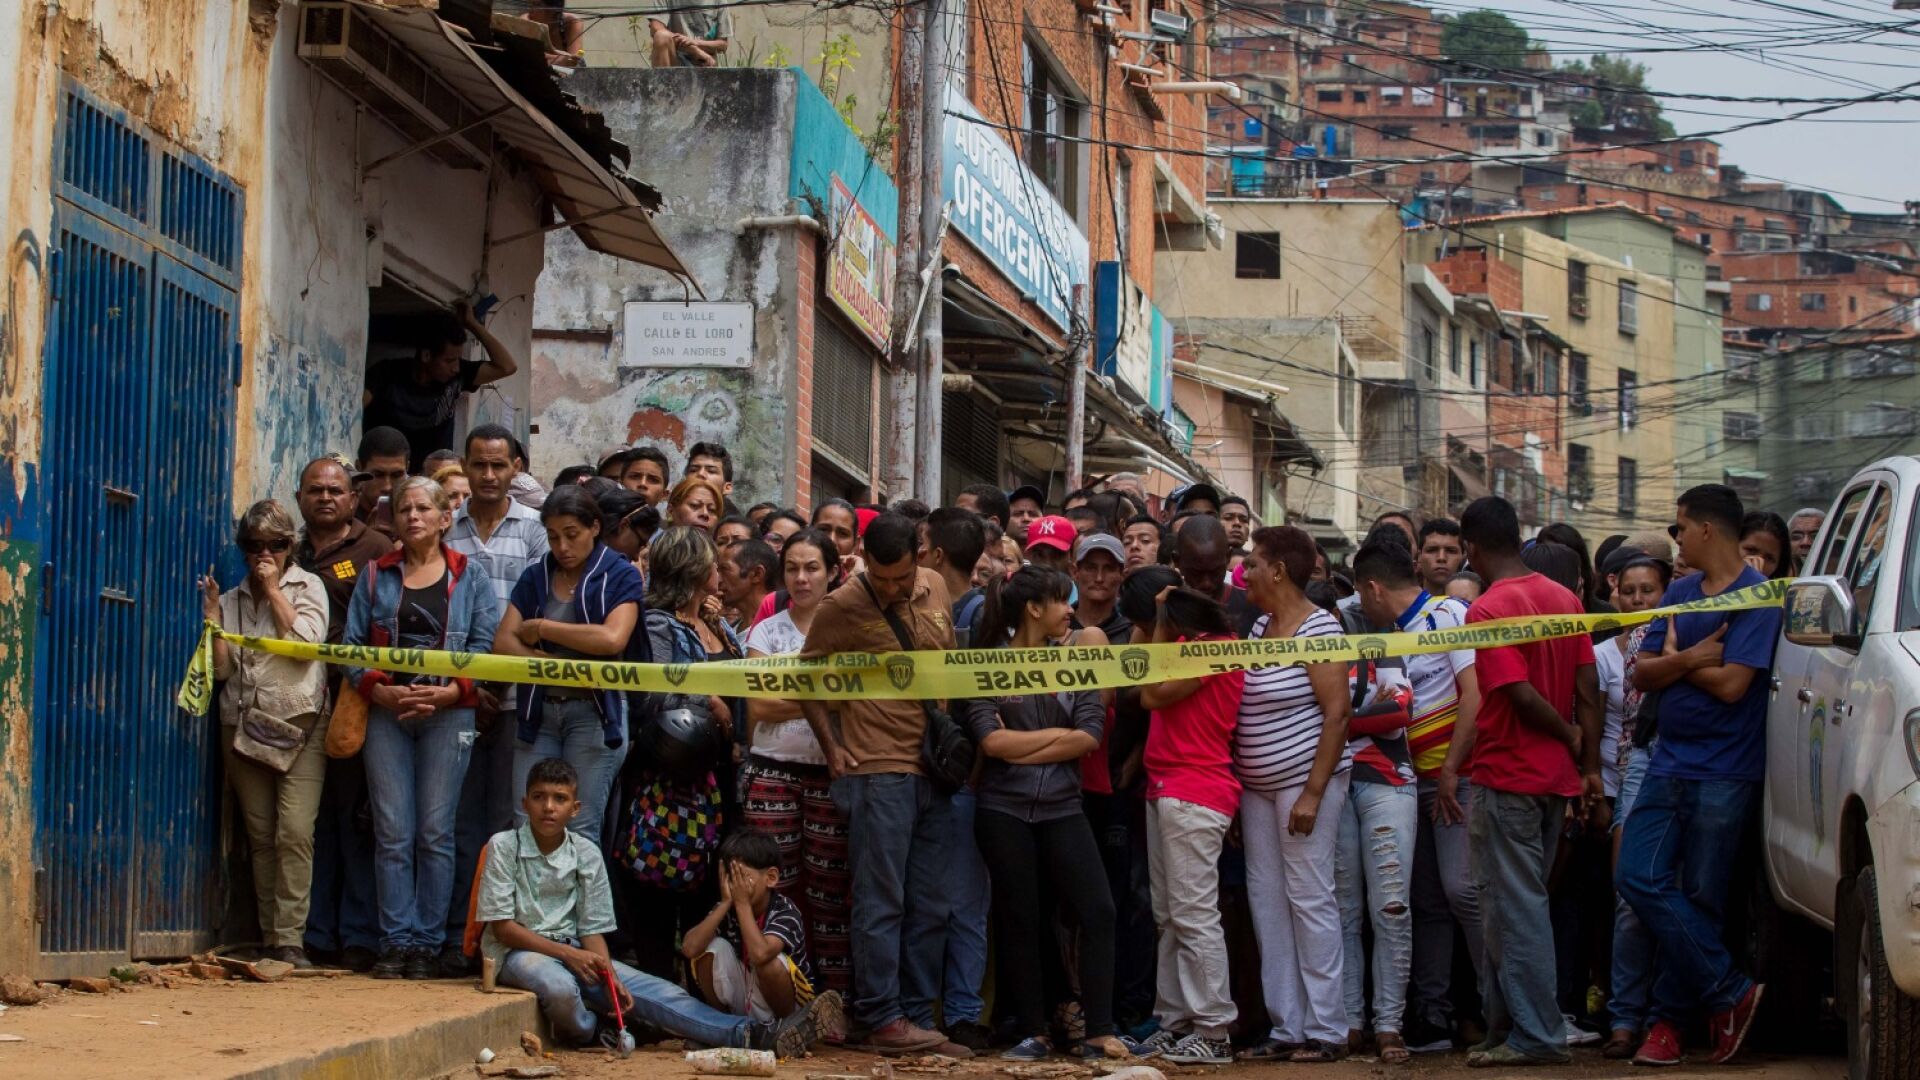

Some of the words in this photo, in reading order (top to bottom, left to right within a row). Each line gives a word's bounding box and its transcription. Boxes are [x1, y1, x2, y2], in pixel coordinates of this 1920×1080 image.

[955, 119, 1071, 263] AUTOMERCADO
[954, 163, 1071, 318] OFERCENTER
[662, 312, 675, 321] EL
[681, 312, 715, 321] VALLE
[644, 328, 679, 338] CALLE
[685, 328, 697, 338] EL
[705, 328, 733, 338] LORO
[652, 347, 674, 356] SAN
[682, 347, 727, 356] ANDRES
